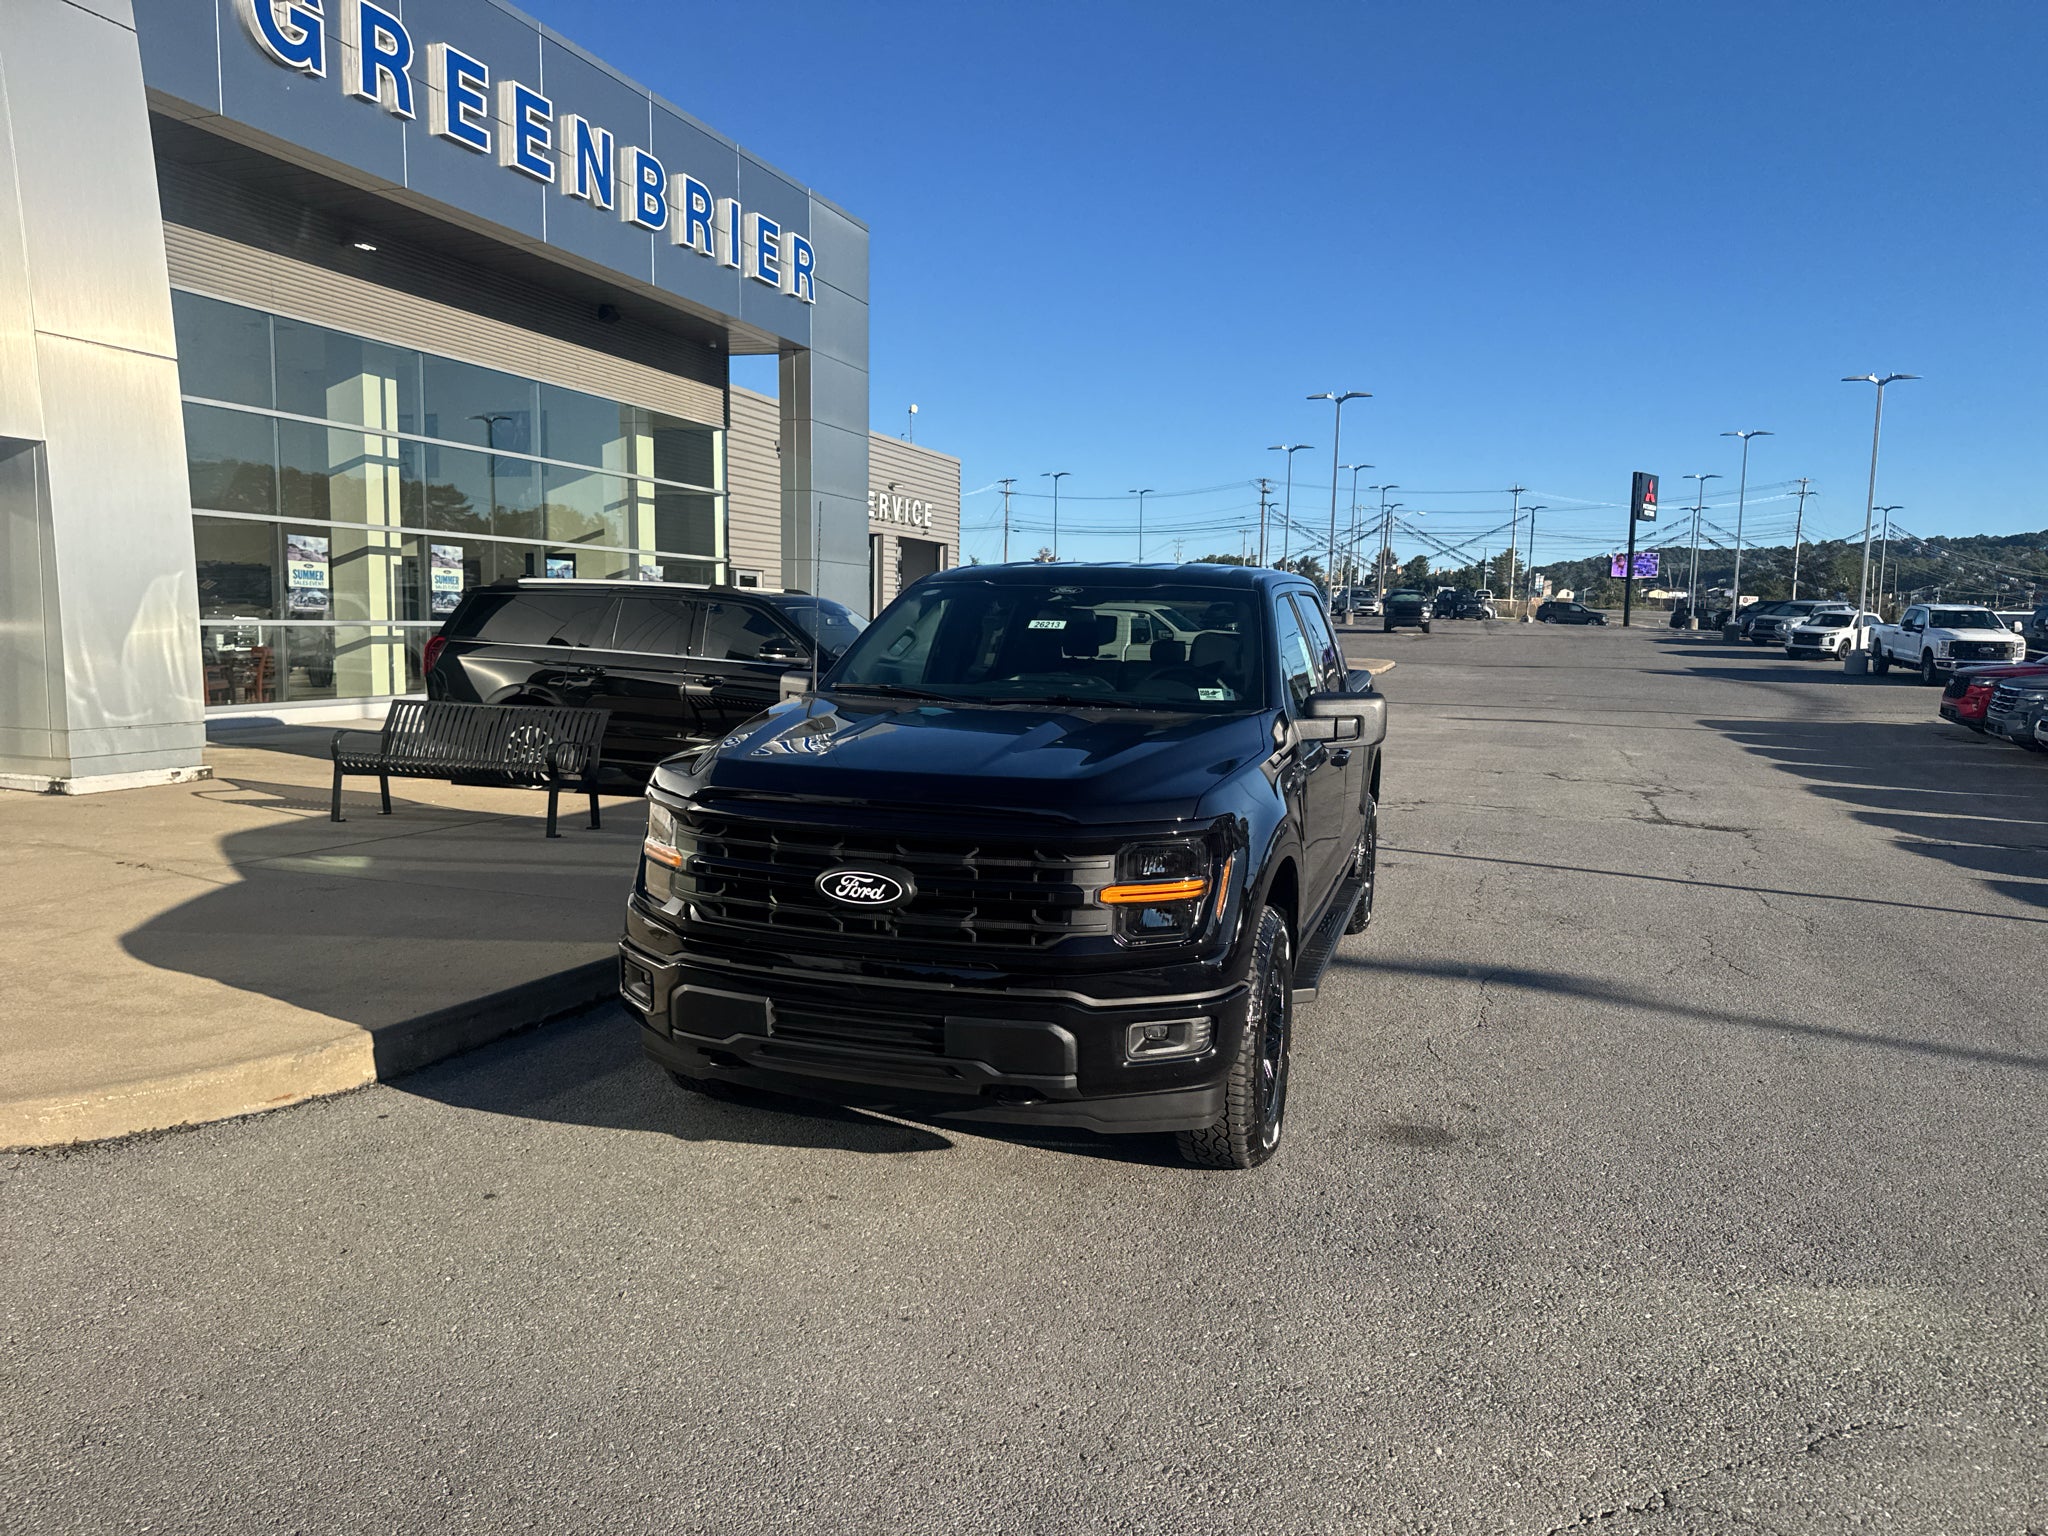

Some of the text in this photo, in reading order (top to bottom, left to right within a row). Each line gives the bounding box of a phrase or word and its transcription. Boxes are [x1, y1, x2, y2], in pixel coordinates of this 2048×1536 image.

[242, 0, 817, 305] GREENBRIER
[293, 569, 324, 580] SUMMER
[434, 575, 459, 585] SUMMER
[835, 875, 886, 899] Ford
